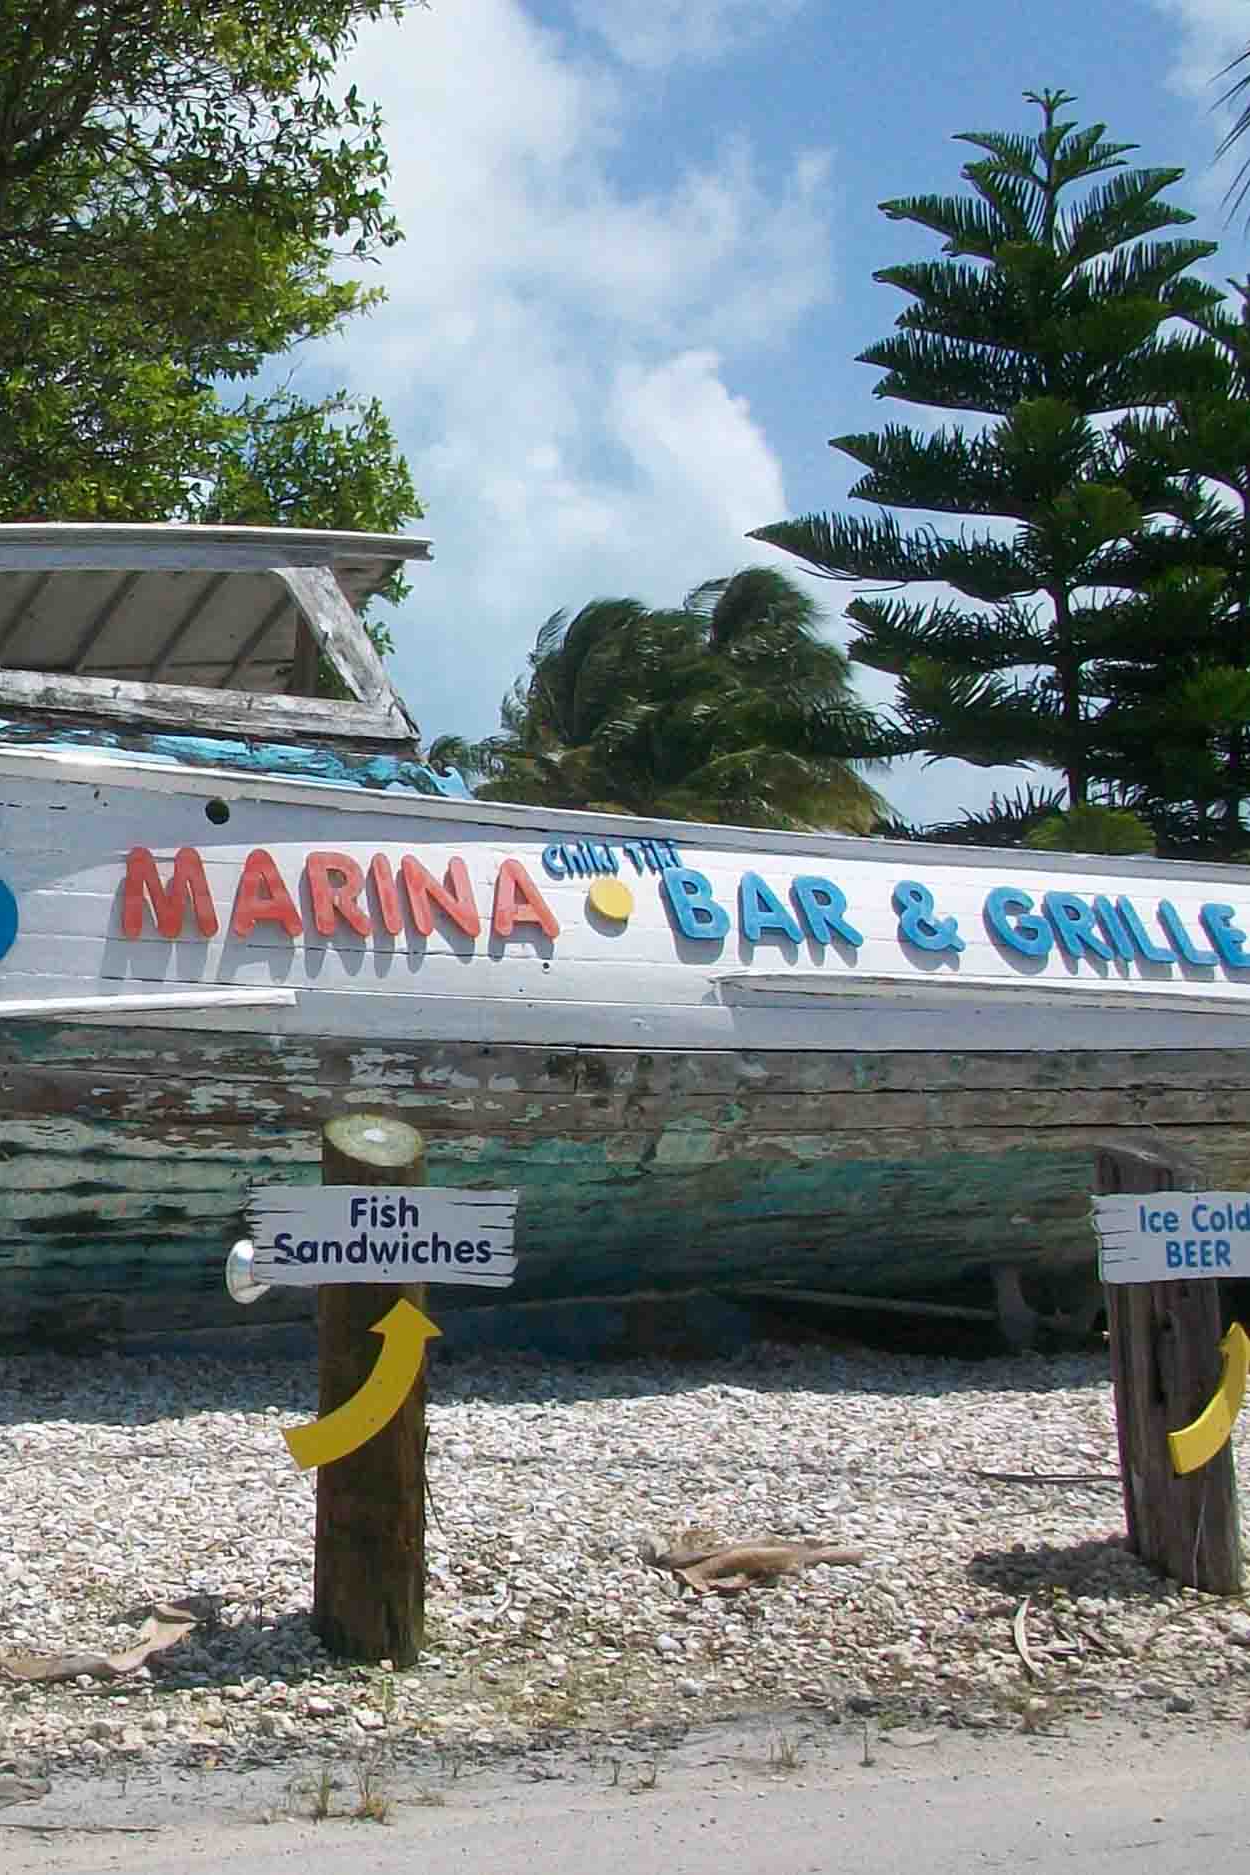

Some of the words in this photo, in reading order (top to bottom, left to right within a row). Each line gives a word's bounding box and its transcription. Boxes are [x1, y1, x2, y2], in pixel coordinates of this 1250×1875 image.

[120, 846, 559, 938] MARINA
[660, 867, 863, 947] BAR
[893, 879, 965, 952] &
[983, 887, 1250, 968] GRILLE
[350, 1195, 419, 1228] Fish
[1139, 1204, 1179, 1232] Ice
[1191, 1202, 1250, 1232] Cold
[273, 1231, 492, 1264] Sandwiches
[1166, 1239, 1231, 1268] BEER
